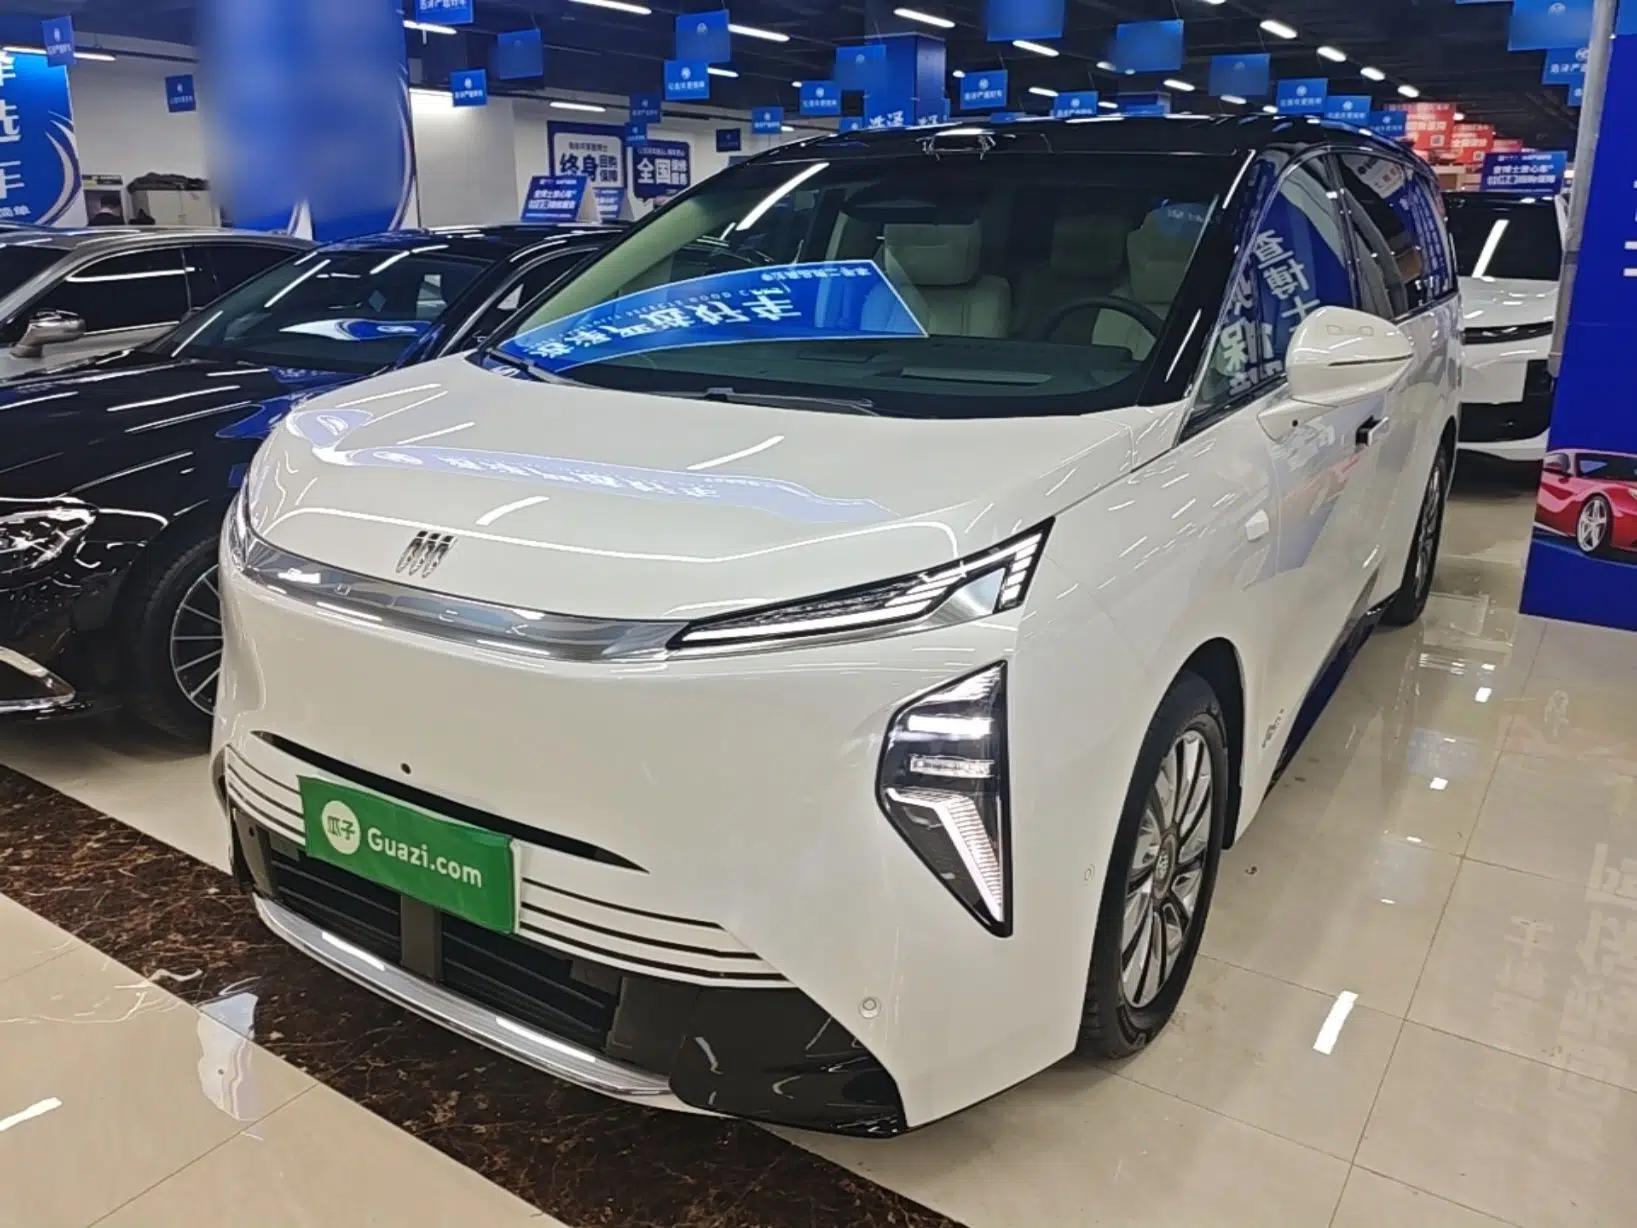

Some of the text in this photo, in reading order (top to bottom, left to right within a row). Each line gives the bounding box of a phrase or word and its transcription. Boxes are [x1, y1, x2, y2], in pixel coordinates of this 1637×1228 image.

[560, 152, 598, 182] 终身
[637, 157, 671, 185] 全国
[326, 815, 356, 841] 瓜子
[366, 826, 483, 889] Guazi.com
